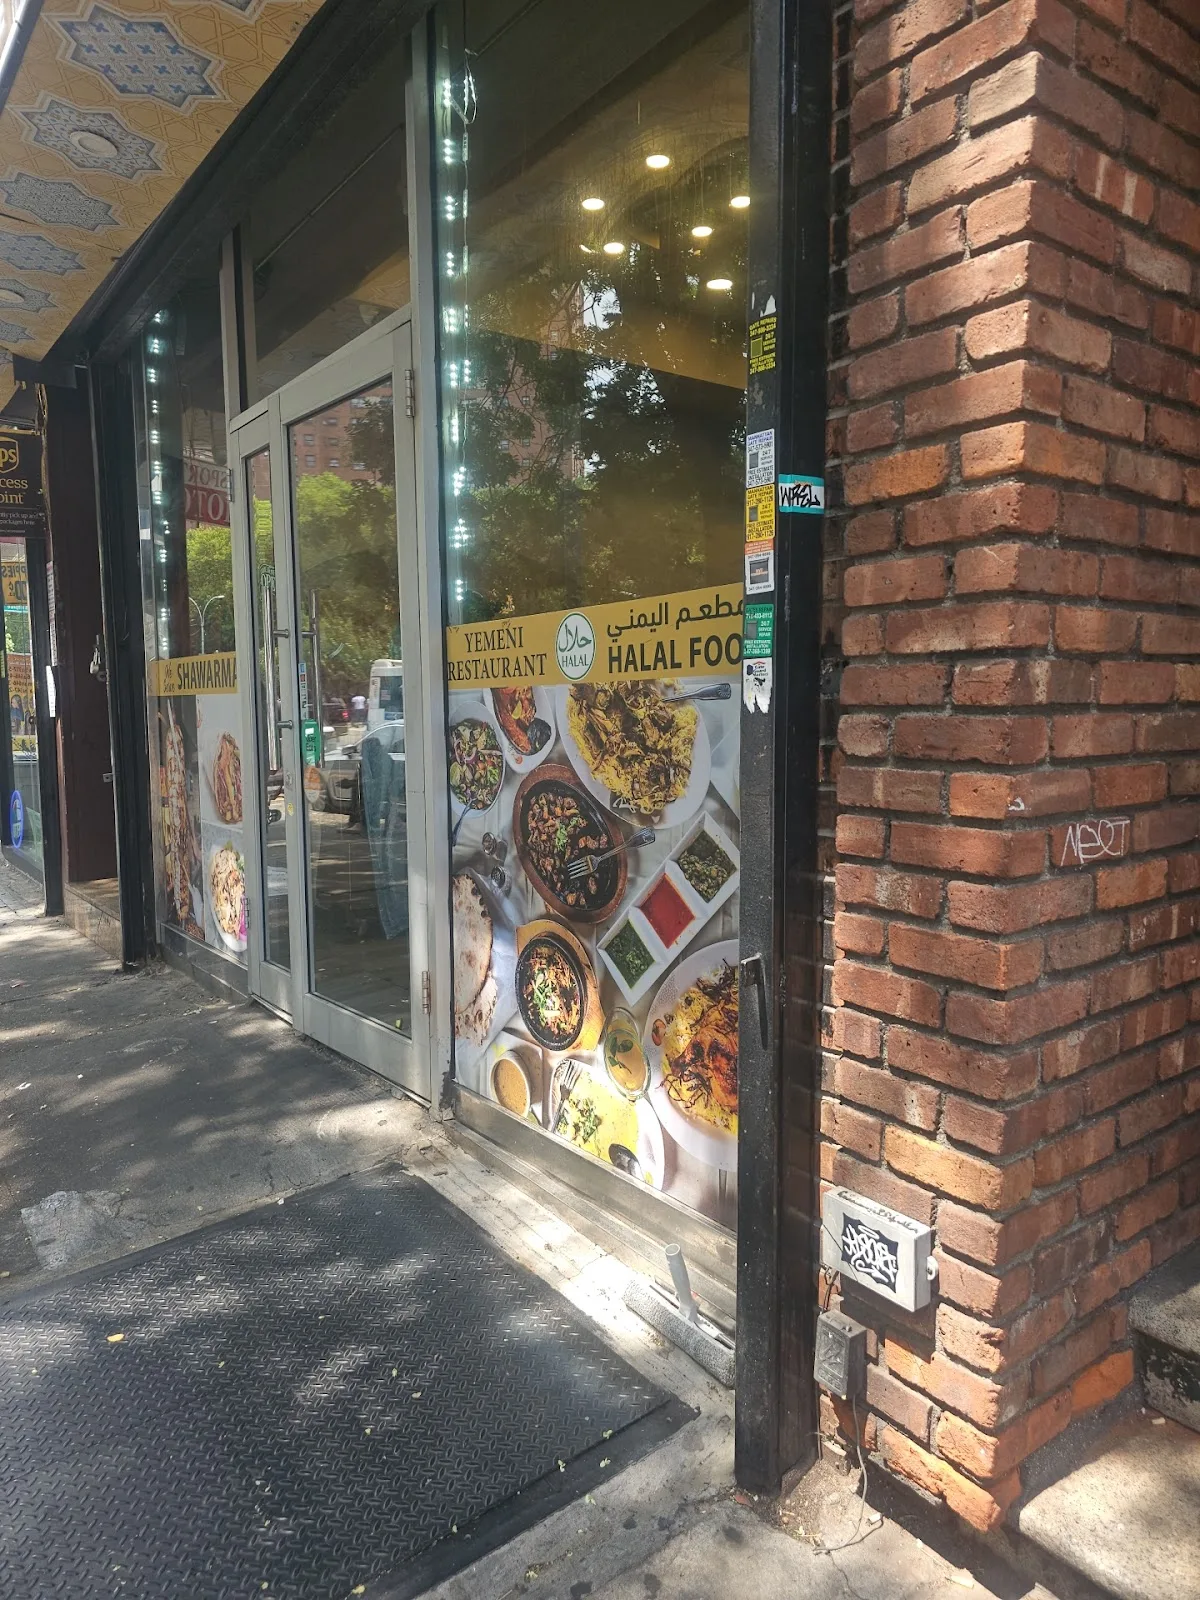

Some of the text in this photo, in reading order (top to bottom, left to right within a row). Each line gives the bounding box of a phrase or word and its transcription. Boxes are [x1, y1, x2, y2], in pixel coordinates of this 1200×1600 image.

[0, 447, 17, 468] ps
[0, 478, 28, 489] cess
[0, 490, 24, 505] oint
[606, 602, 669, 643] اليمني
[464, 626, 524, 653] YEMENI
[558, 622, 592, 653] حلال
[561, 653, 589, 668] HALAL
[608, 632, 743, 674] HALAL FOO
[447, 653, 547, 681] RESTAURANT
